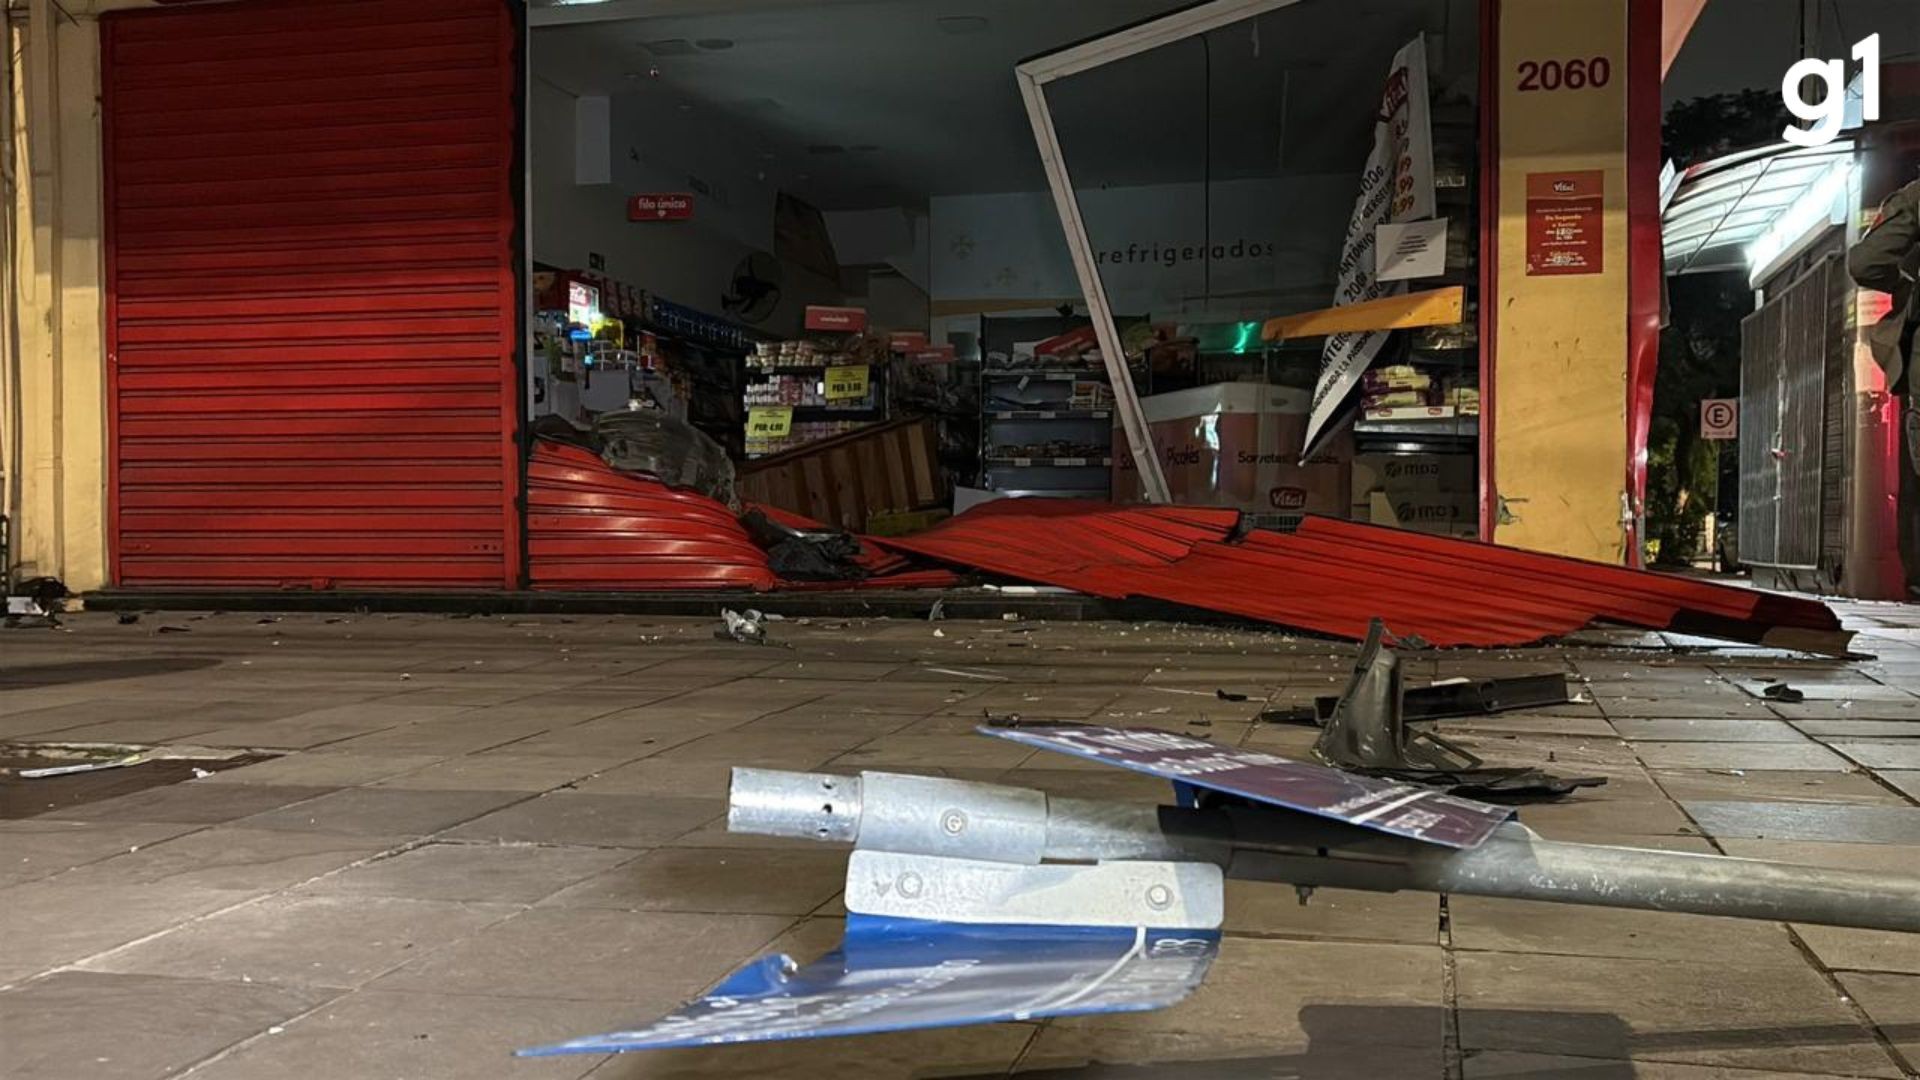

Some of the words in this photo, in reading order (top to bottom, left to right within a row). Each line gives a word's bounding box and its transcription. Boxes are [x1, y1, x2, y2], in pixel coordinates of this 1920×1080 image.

[1517, 56, 1611, 92] 2060
[1098, 239, 1273, 267] refrigerados
[1713, 407, 1724, 424] E
[1271, 488, 1303, 506] Vital
